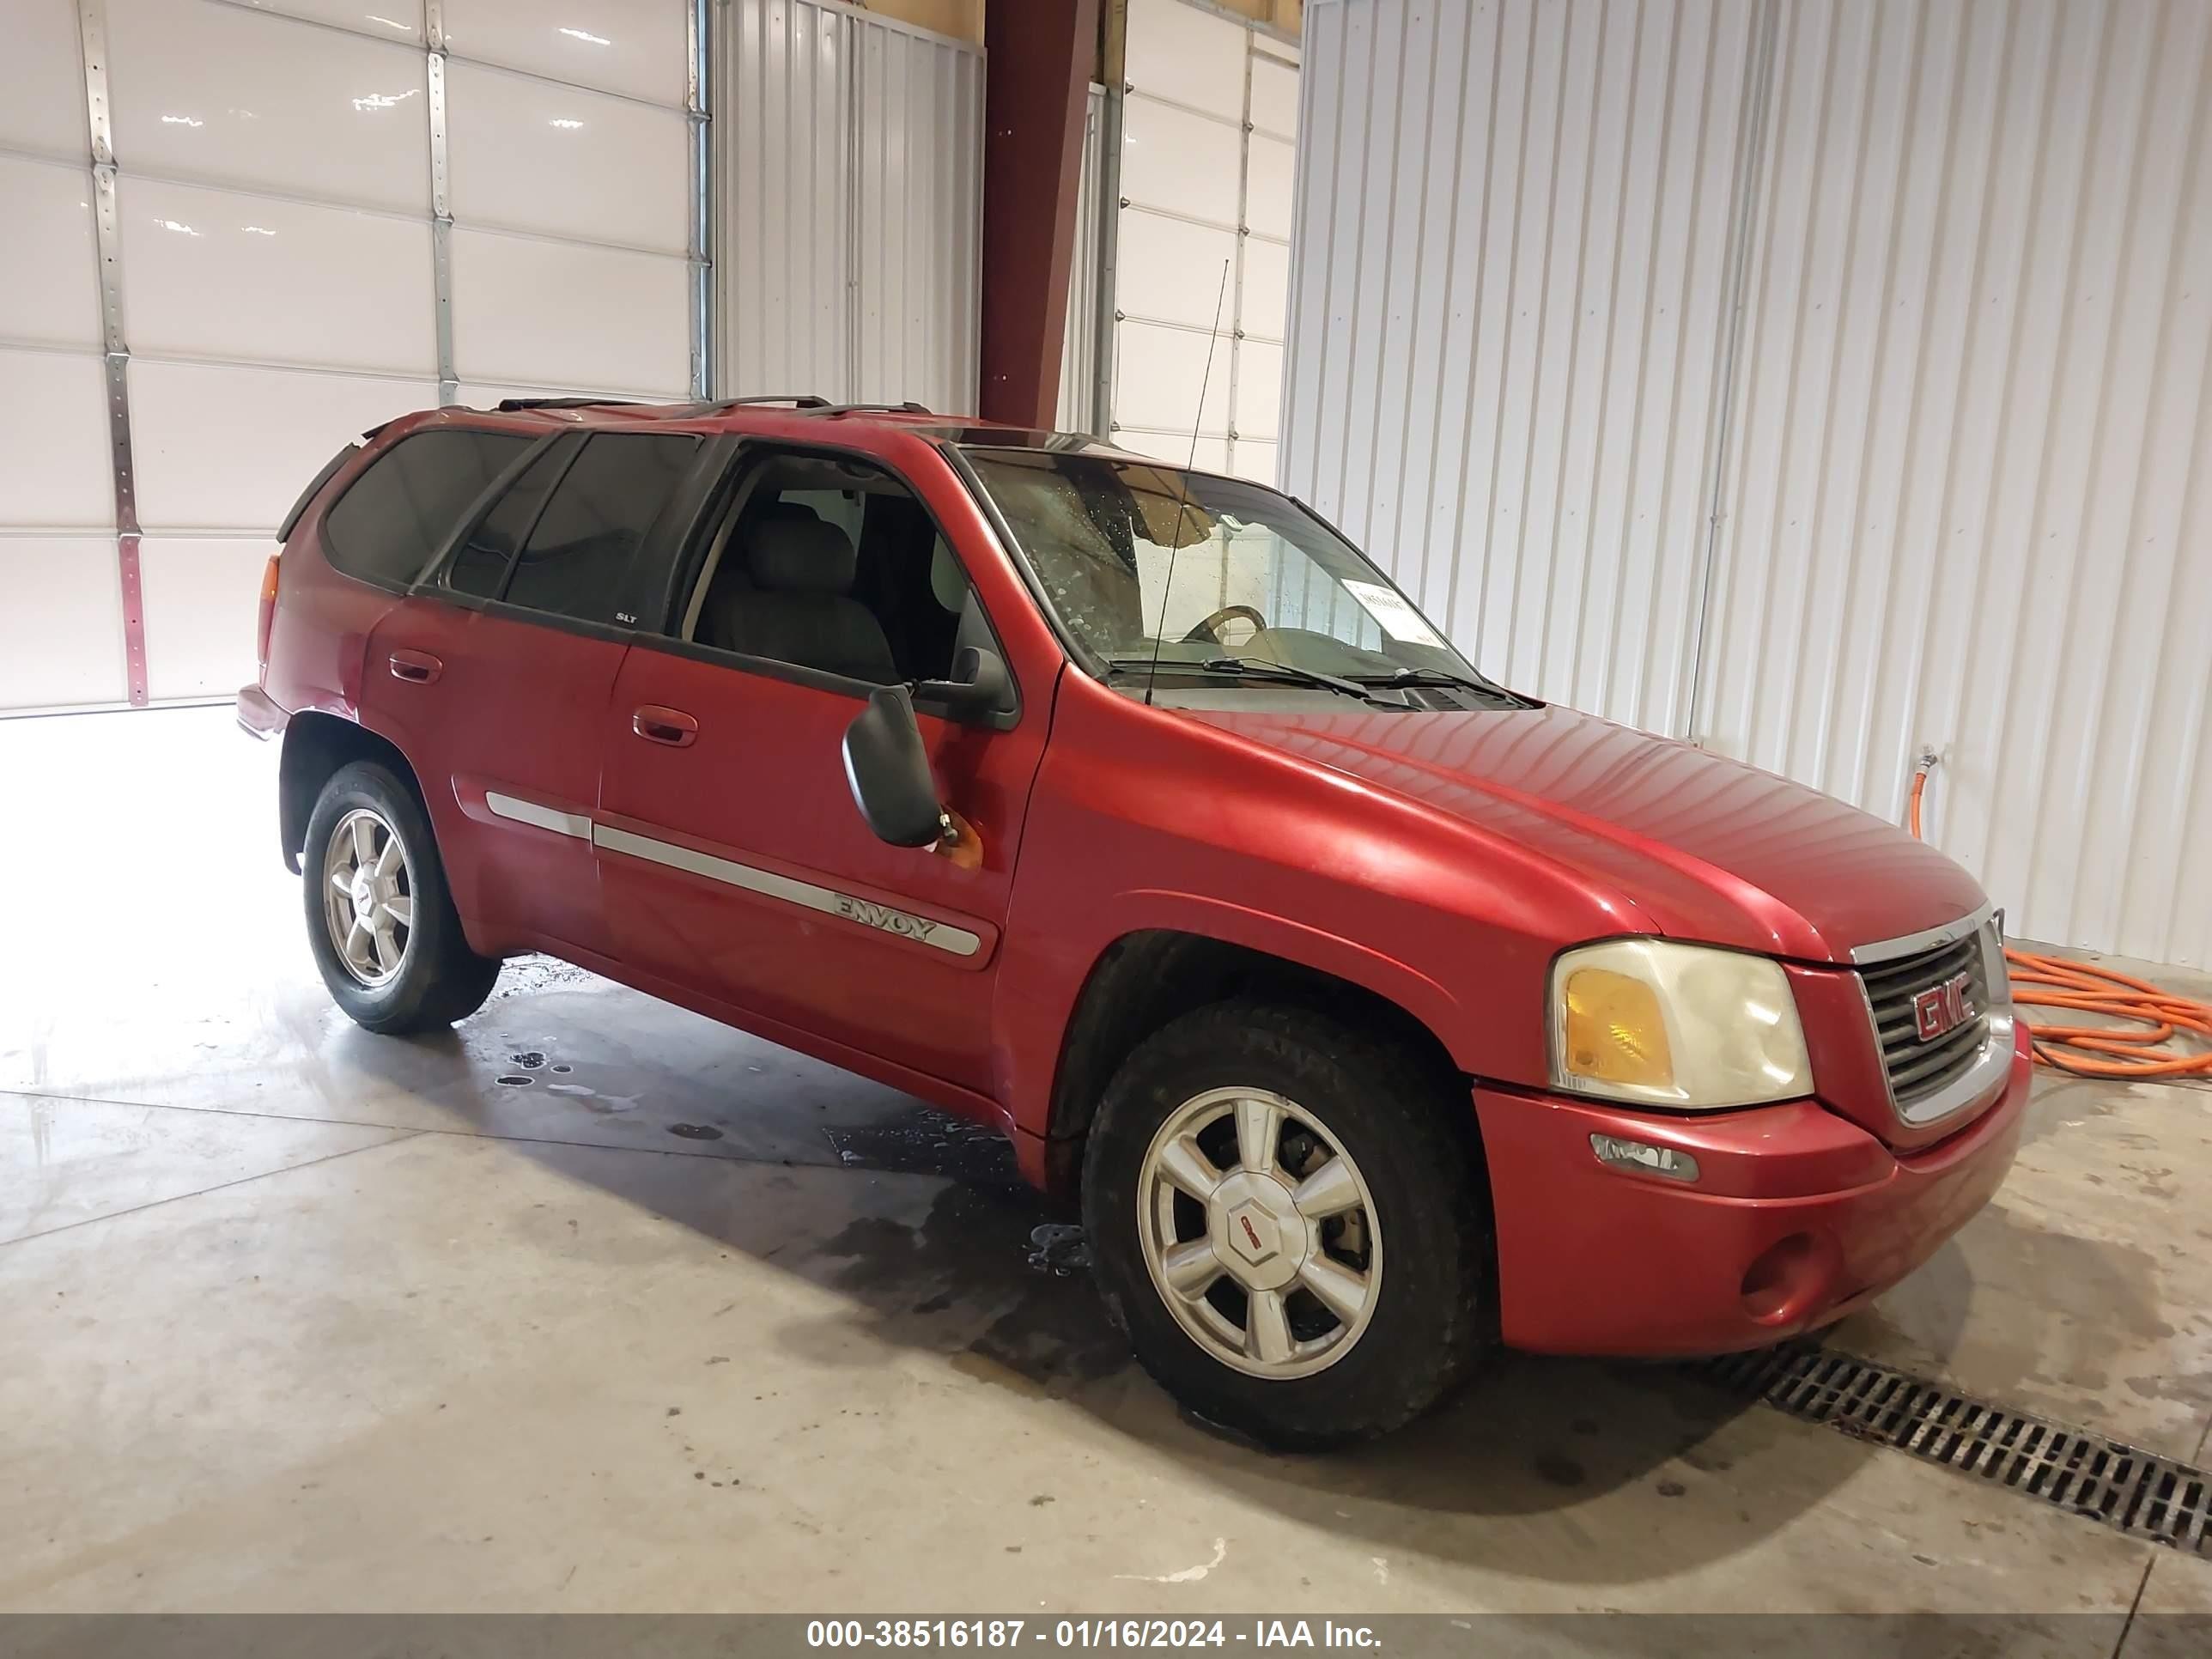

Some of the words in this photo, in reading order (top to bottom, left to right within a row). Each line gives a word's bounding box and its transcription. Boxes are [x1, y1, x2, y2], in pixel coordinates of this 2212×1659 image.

[615, 612, 637, 624] SLT
[834, 894, 937, 941] ENVOY
[1912, 971, 1975, 1042] GMC
